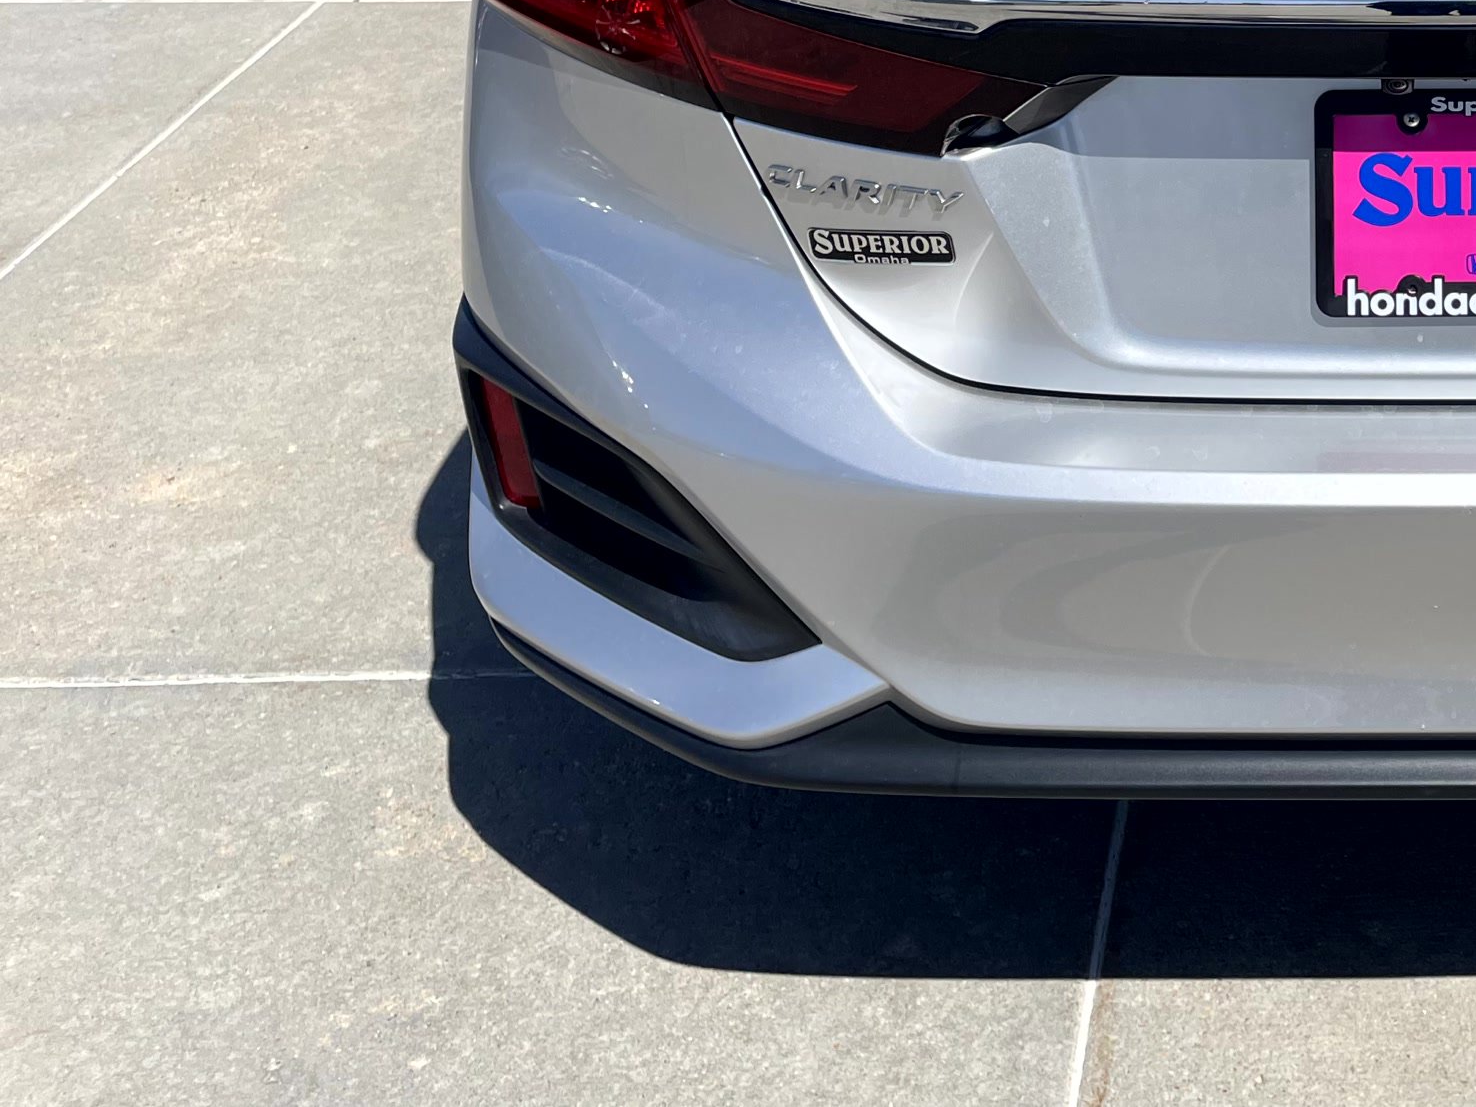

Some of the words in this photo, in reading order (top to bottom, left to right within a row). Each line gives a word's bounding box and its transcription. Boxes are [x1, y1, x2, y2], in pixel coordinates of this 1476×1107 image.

[767, 163, 965, 214] CLARITY
[813, 229, 950, 255] SUPERIOR
[854, 254, 911, 265] Omaha
